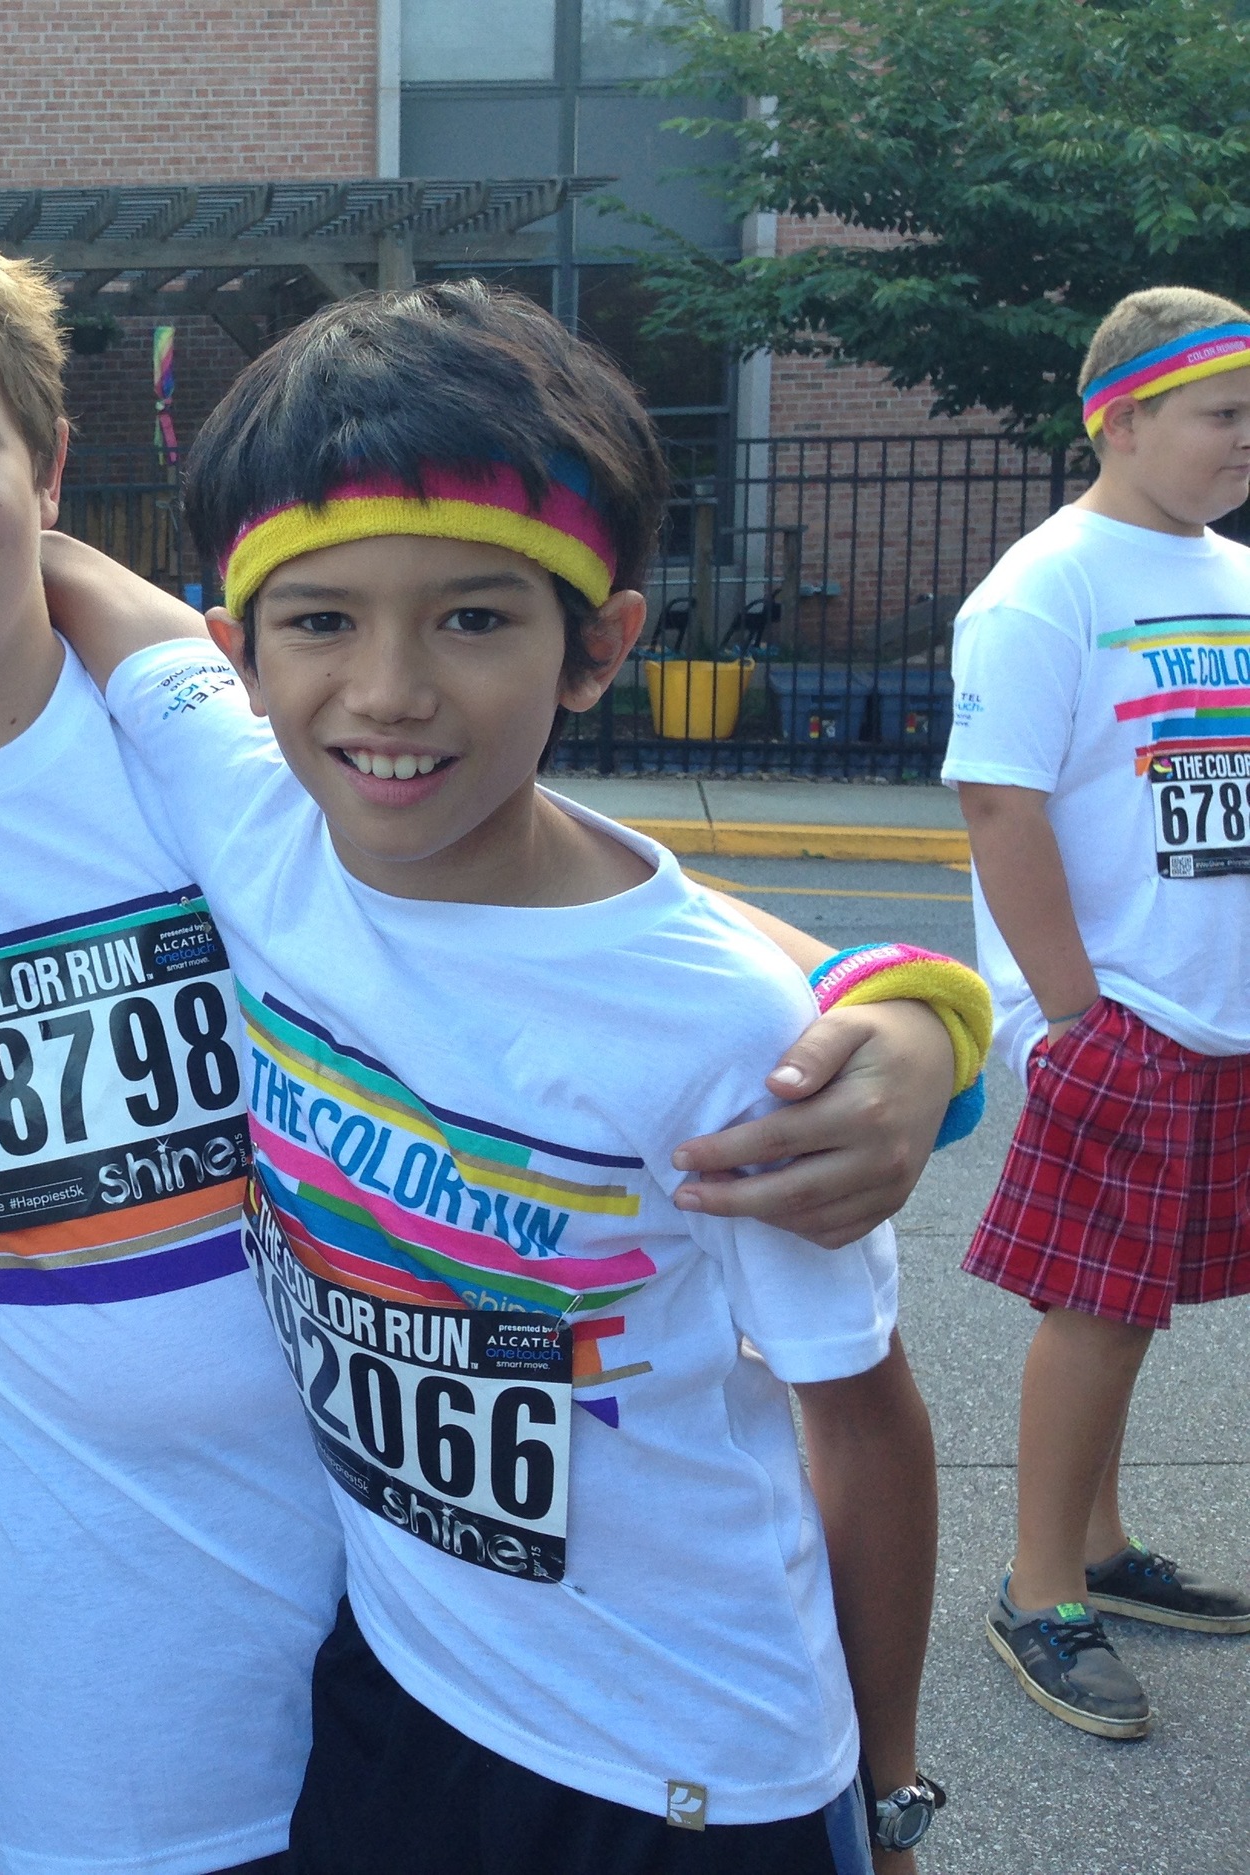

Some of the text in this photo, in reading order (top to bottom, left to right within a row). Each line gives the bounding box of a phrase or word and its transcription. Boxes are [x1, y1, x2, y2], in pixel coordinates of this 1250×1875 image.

[1142, 647, 1198, 688] THE
[1171, 755, 1205, 780] THE
[1160, 782, 1250, 846] 678
[154, 934, 213, 954] ALCATEL
[160, 924, 194, 940] presented
[65, 936, 146, 999] RUN
[166, 957, 210, 972] smart move.
[821, 947, 900, 992] RUNNER
[234, 1133, 243, 1145] 15
[251, 1047, 306, 1143] THE
[308, 1097, 468, 1225] COLOR
[99, 1136, 238, 1205] shine
[10, 1185, 85, 1210] #Happiest5k
[259, 1195, 284, 1271] THE
[282, 1248, 377, 1347] COLOR
[385, 1308, 470, 1369] RUN
[498, 1324, 540, 1333] presented
[486, 1335, 561, 1348] ALCATEL
[496, 1360, 551, 1370] smart move.
[381, 1486, 529, 1573] shine
[530, 1545, 541, 1557] 15
